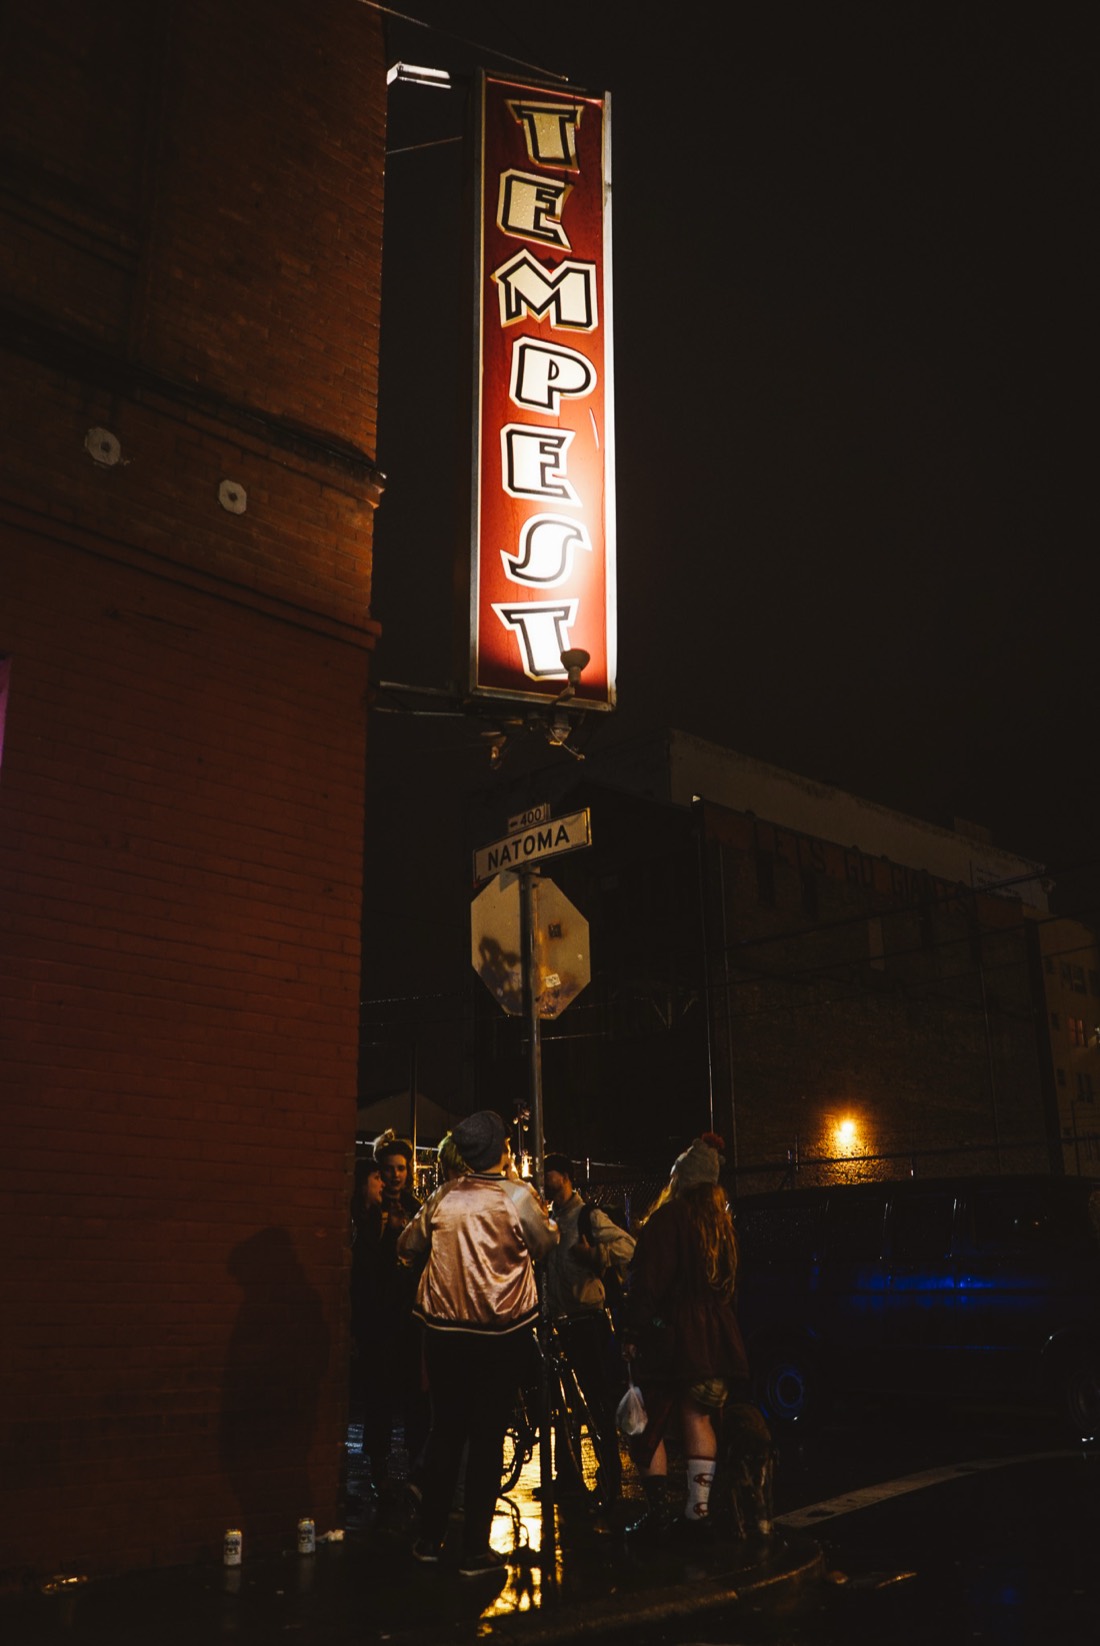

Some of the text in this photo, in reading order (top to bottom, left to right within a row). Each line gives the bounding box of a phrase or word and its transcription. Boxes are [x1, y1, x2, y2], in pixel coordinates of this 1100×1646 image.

[490, 98, 598, 681] TEMPEST
[520, 808, 542, 826] 400
[488, 824, 570, 871] NATOMA
